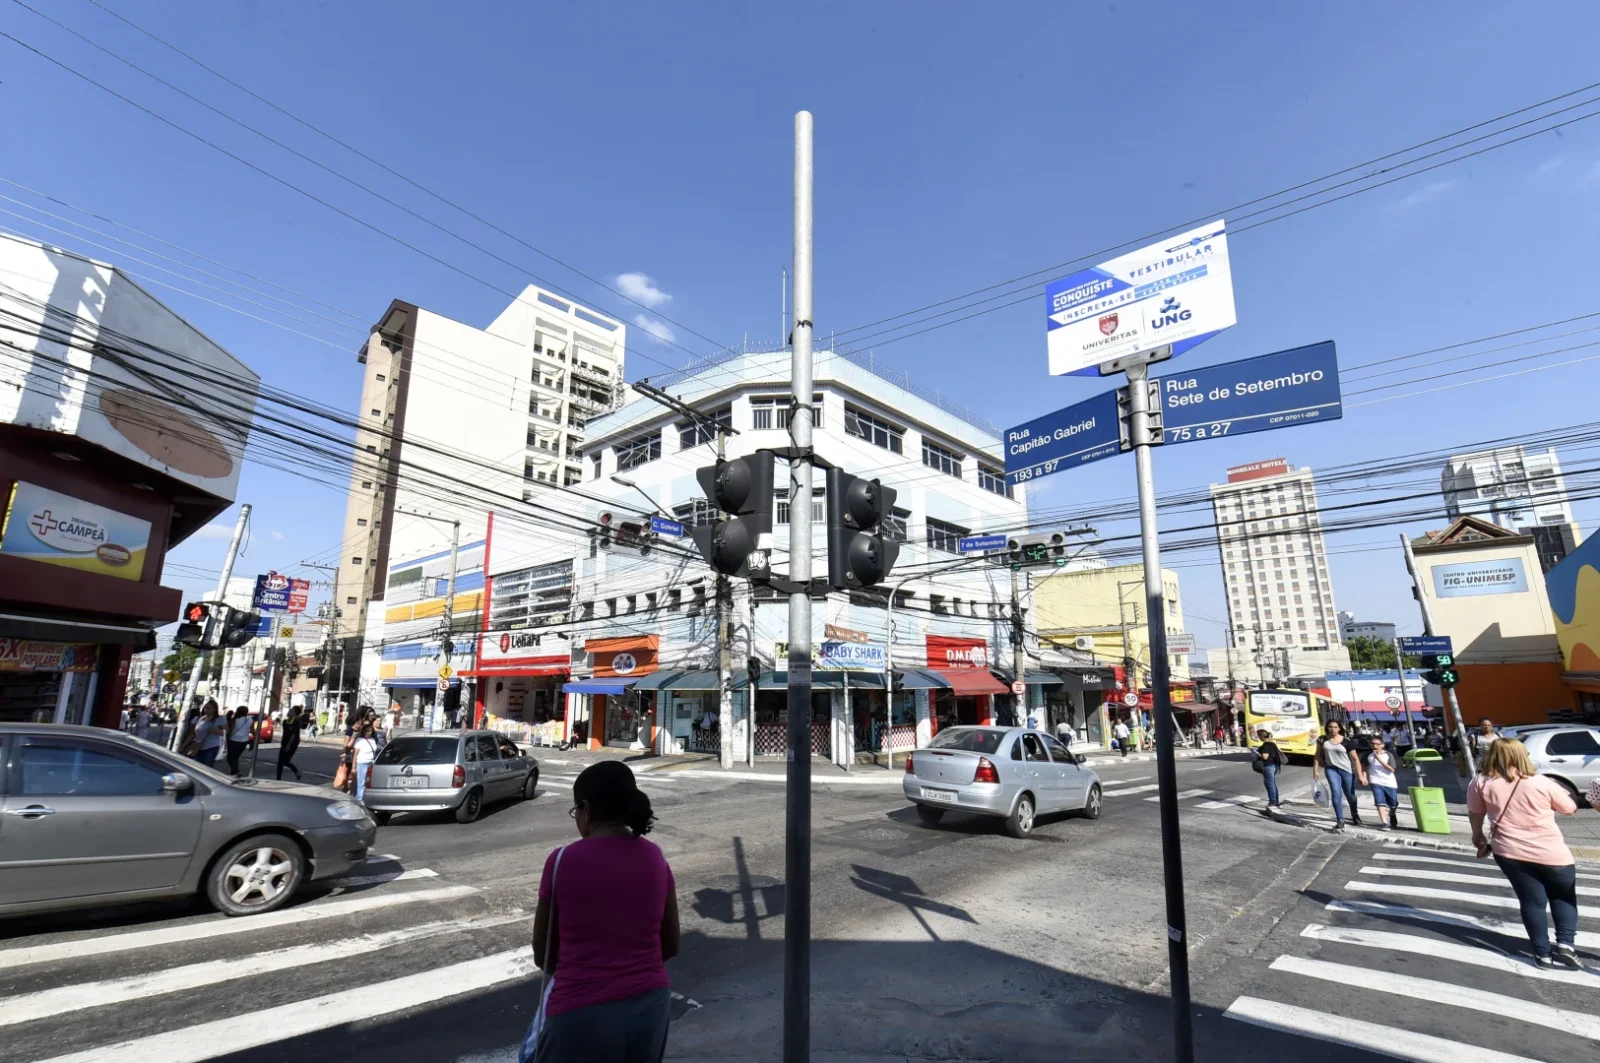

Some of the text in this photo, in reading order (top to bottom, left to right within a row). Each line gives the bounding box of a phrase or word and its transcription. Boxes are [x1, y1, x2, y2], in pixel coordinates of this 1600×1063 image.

[1129, 244, 1212, 278] VESTIBULAR
[1053, 278, 1114, 308] CONQUISTE
[1063, 291, 1133, 321] INSCREVA-SE
[1152, 309, 1192, 329] UNG
[1082, 329, 1138, 351] UNIVERITAS
[1166, 378, 1198, 393] Rua
[1168, 369, 1324, 408] Sete de Setembro
[1269, 411, 1320, 424] CEP 07011-020
[1009, 428, 1030, 442] Rua
[1010, 416, 1096, 455] Capitão Gabriel
[1171, 422, 1232, 442] 75 a 27
[1081, 453, 1091, 461] CEP
[1013, 460, 1059, 482] 193 a 97
[71, 517, 98, 528] DROGARIAS
[58, 521, 105, 541] CAMPEÃ
[1467, 567, 1514, 576] UNIVERSITÁRIO
[1443, 573, 1516, 586] FIG-UNIMESP
[254, 595, 288, 606] Britânico
[260, 590, 285, 600] Centro
[511, 633, 541, 648] Uehara
[22, 653, 60, 666] POPULARES
[825, 645, 882, 660] BABY SHARK
